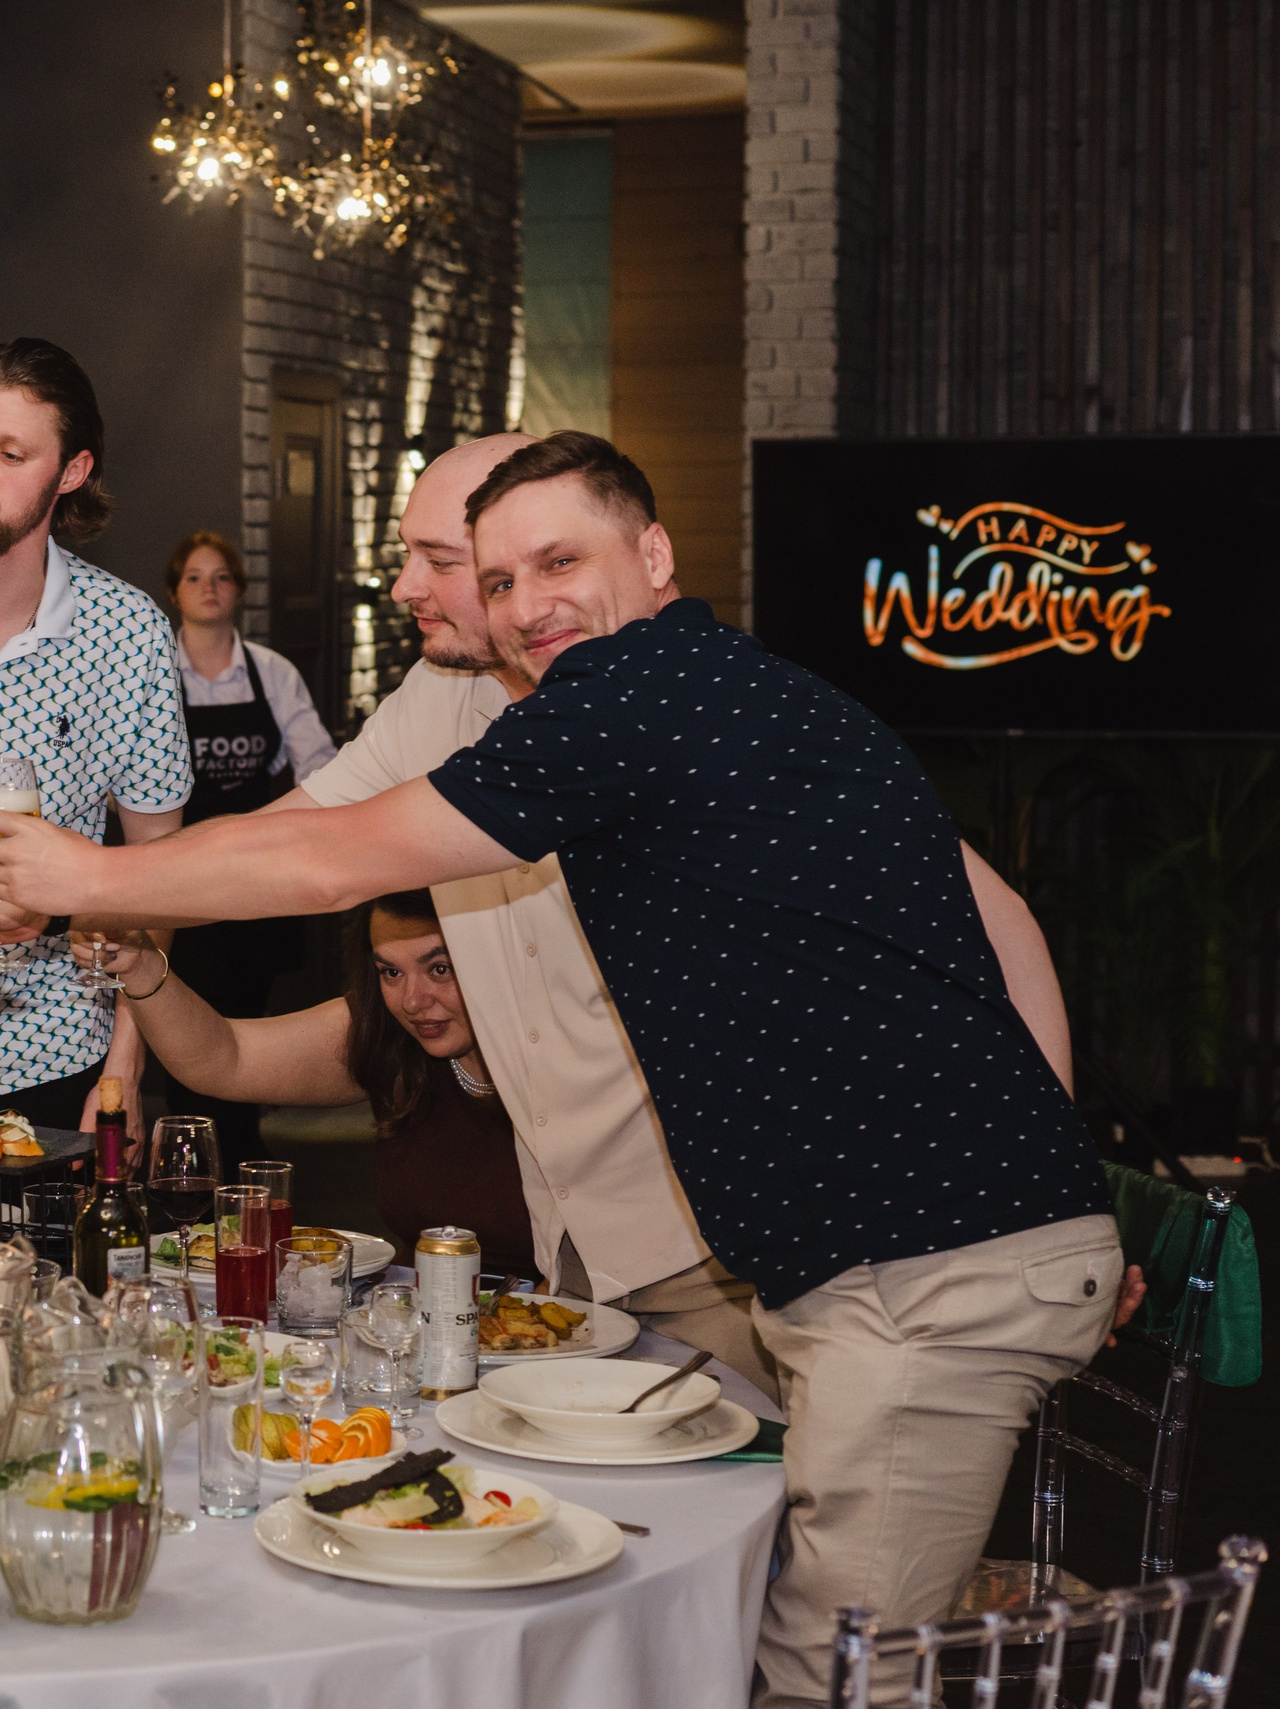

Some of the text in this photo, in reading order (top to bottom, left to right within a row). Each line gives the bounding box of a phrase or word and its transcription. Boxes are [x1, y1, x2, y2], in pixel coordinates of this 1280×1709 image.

[977, 516, 1100, 565] HAPPY
[862, 543, 1173, 668] Wedding
[194, 735, 266, 757] FOOD
[195, 756, 265, 772] FACTORY
